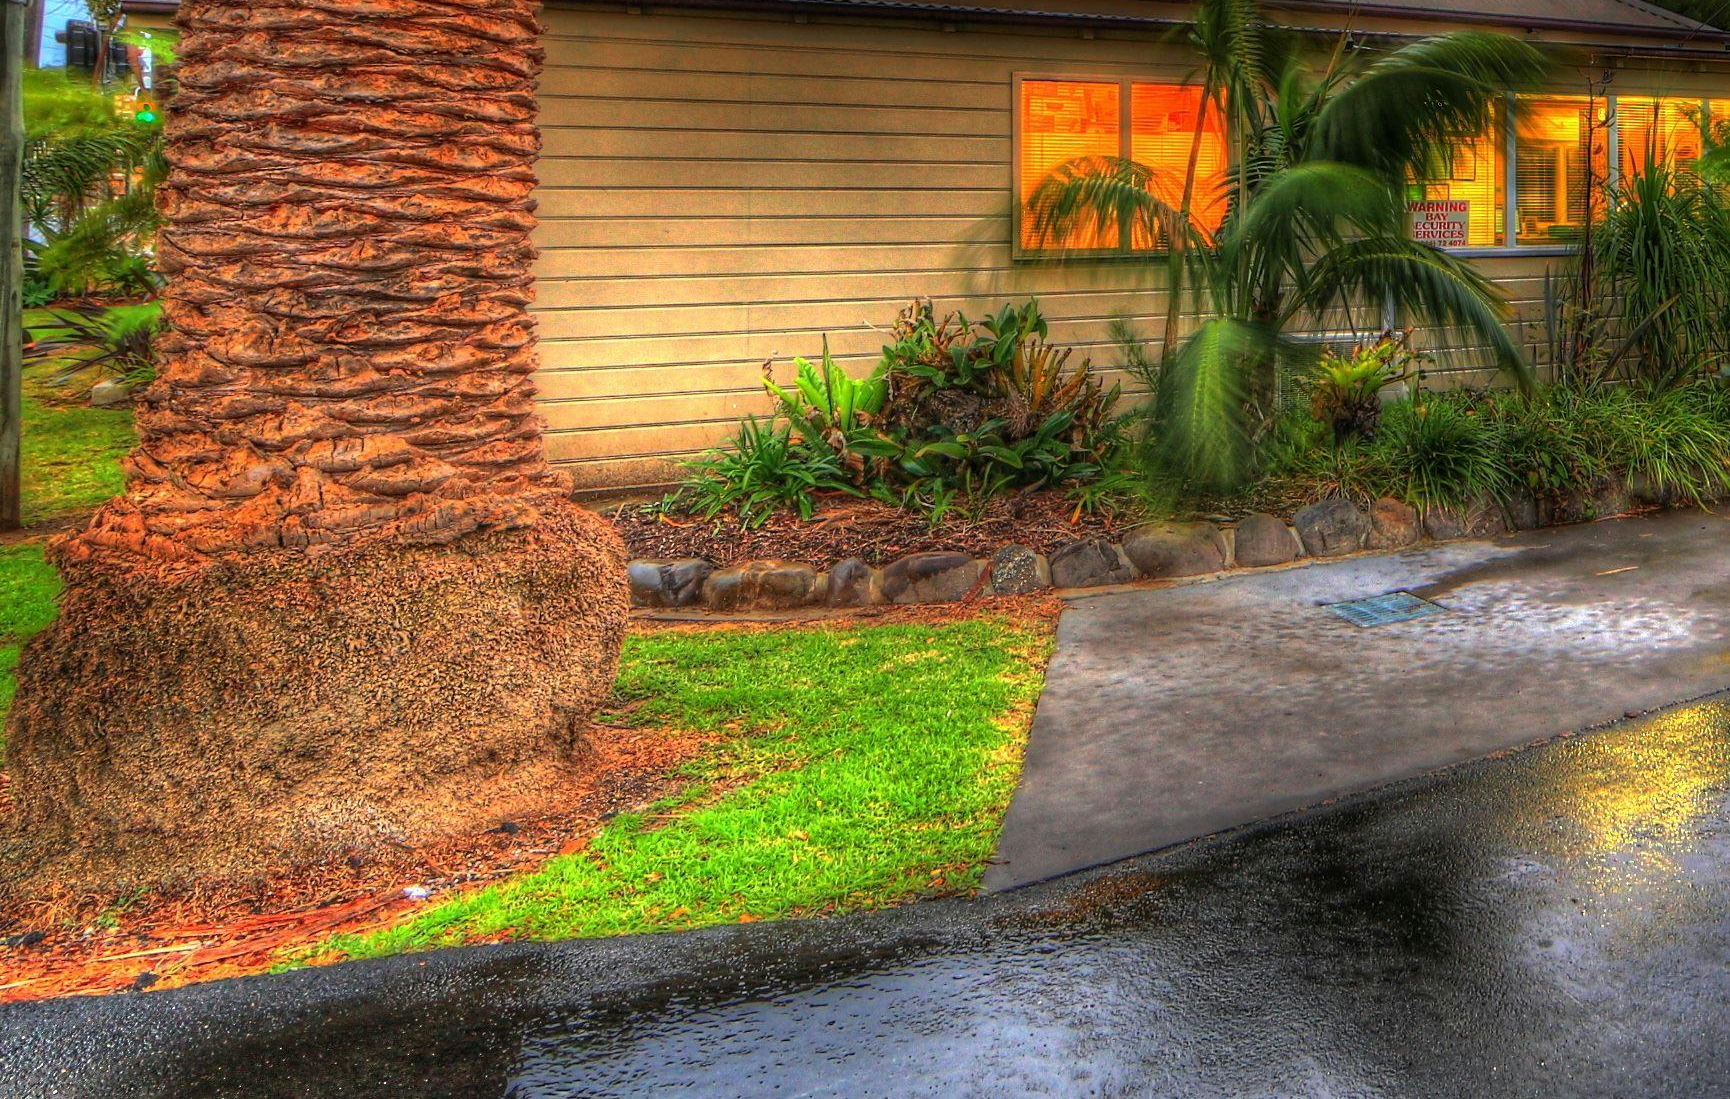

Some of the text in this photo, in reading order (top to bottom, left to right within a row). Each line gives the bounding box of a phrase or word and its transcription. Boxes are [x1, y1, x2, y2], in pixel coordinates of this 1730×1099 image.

[1408, 202, 1467, 212] WARNING
[1425, 213, 1449, 221] BAY
[1413, 221, 1465, 230] ECURITY
[1413, 230, 1464, 239] ERVICES
